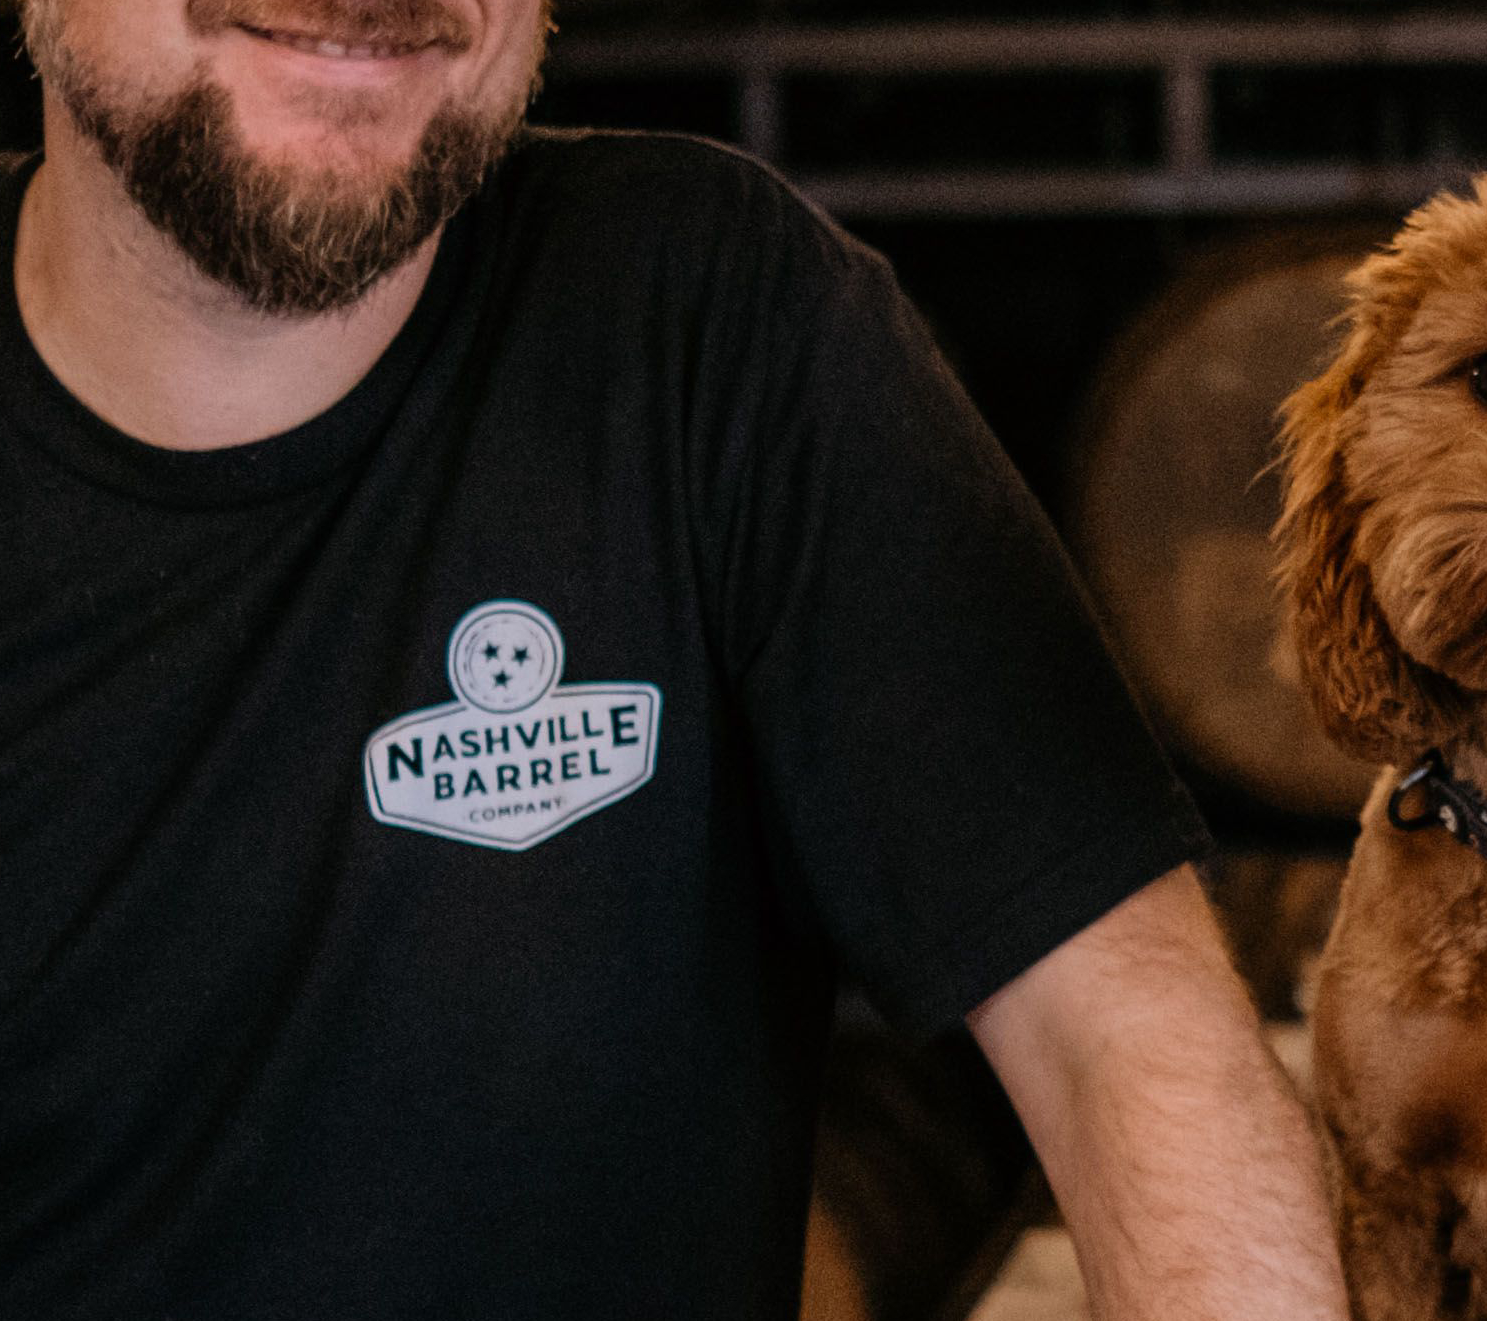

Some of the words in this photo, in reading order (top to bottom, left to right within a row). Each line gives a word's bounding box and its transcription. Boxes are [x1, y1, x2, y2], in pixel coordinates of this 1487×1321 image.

[386, 704, 640, 782] NASHVILLE
[433, 748, 611, 802] BARREL
[468, 796, 563, 824] COMPANY
